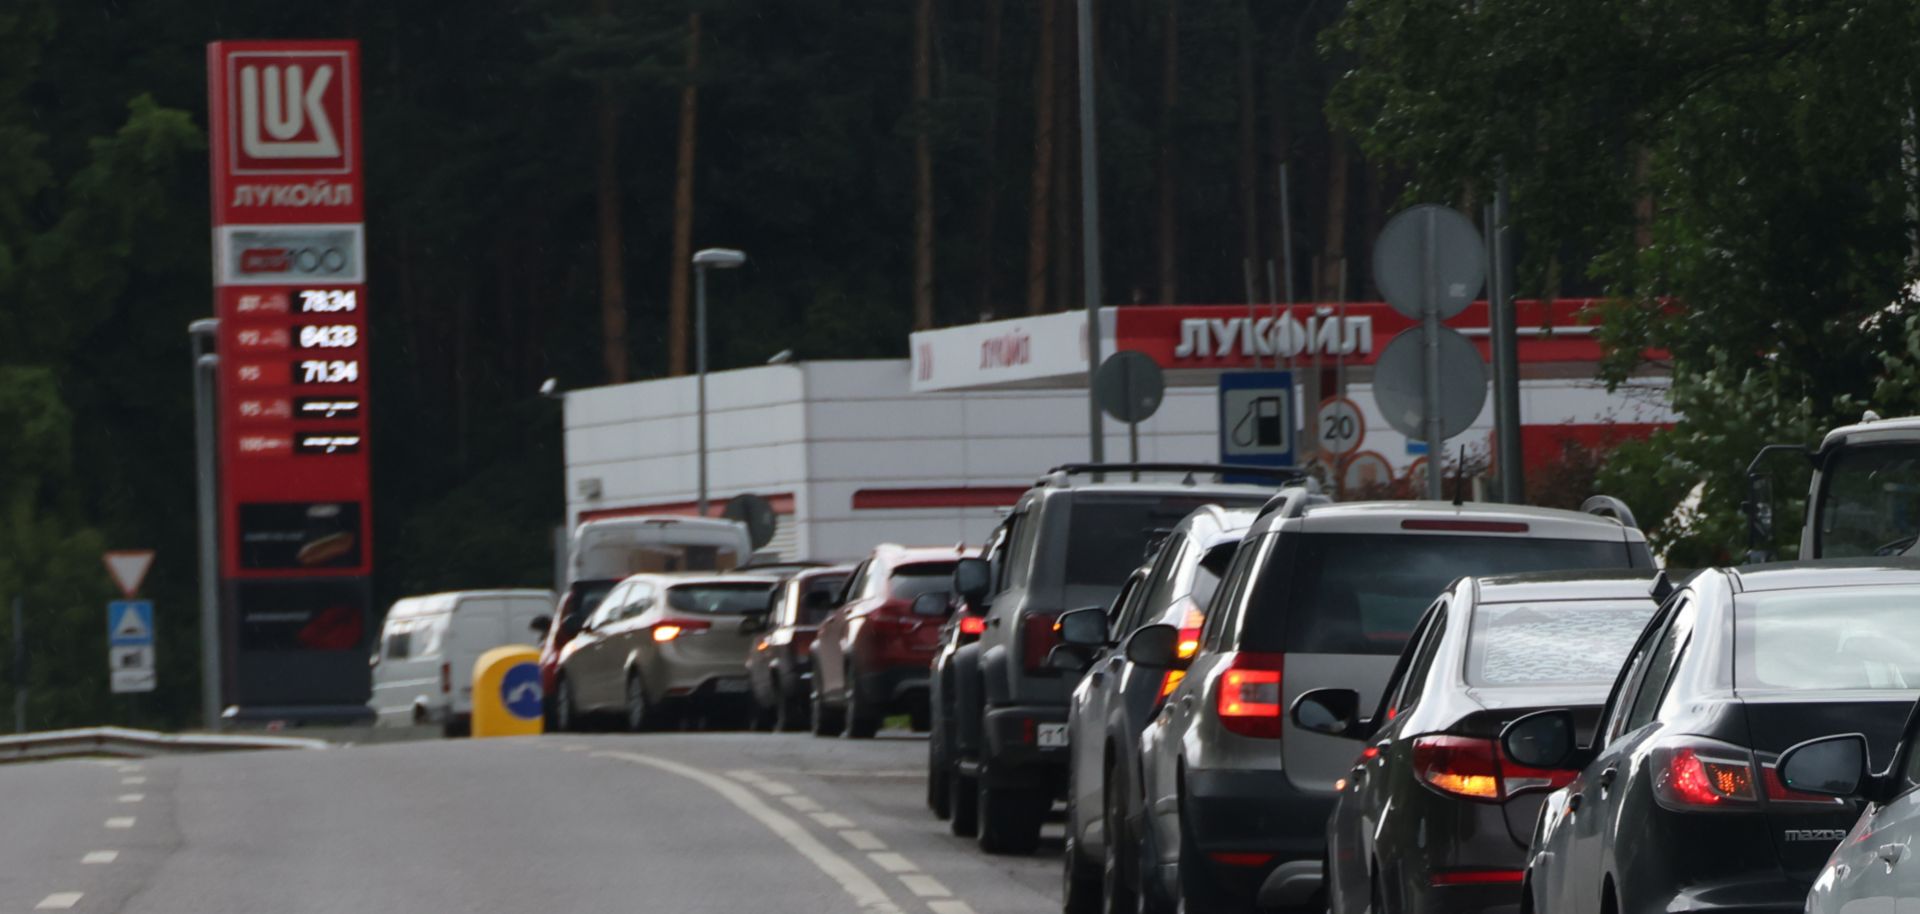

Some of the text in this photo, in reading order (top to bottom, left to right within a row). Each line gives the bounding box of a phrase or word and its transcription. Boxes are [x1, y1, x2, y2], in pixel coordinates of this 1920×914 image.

[232, 179, 353, 207] ЛУКОЙЛ
[1174, 307, 1373, 358] ЛУКОЙЛ
[1323, 415, 1354, 440] 20
[1784, 829, 1847, 841] mazda
